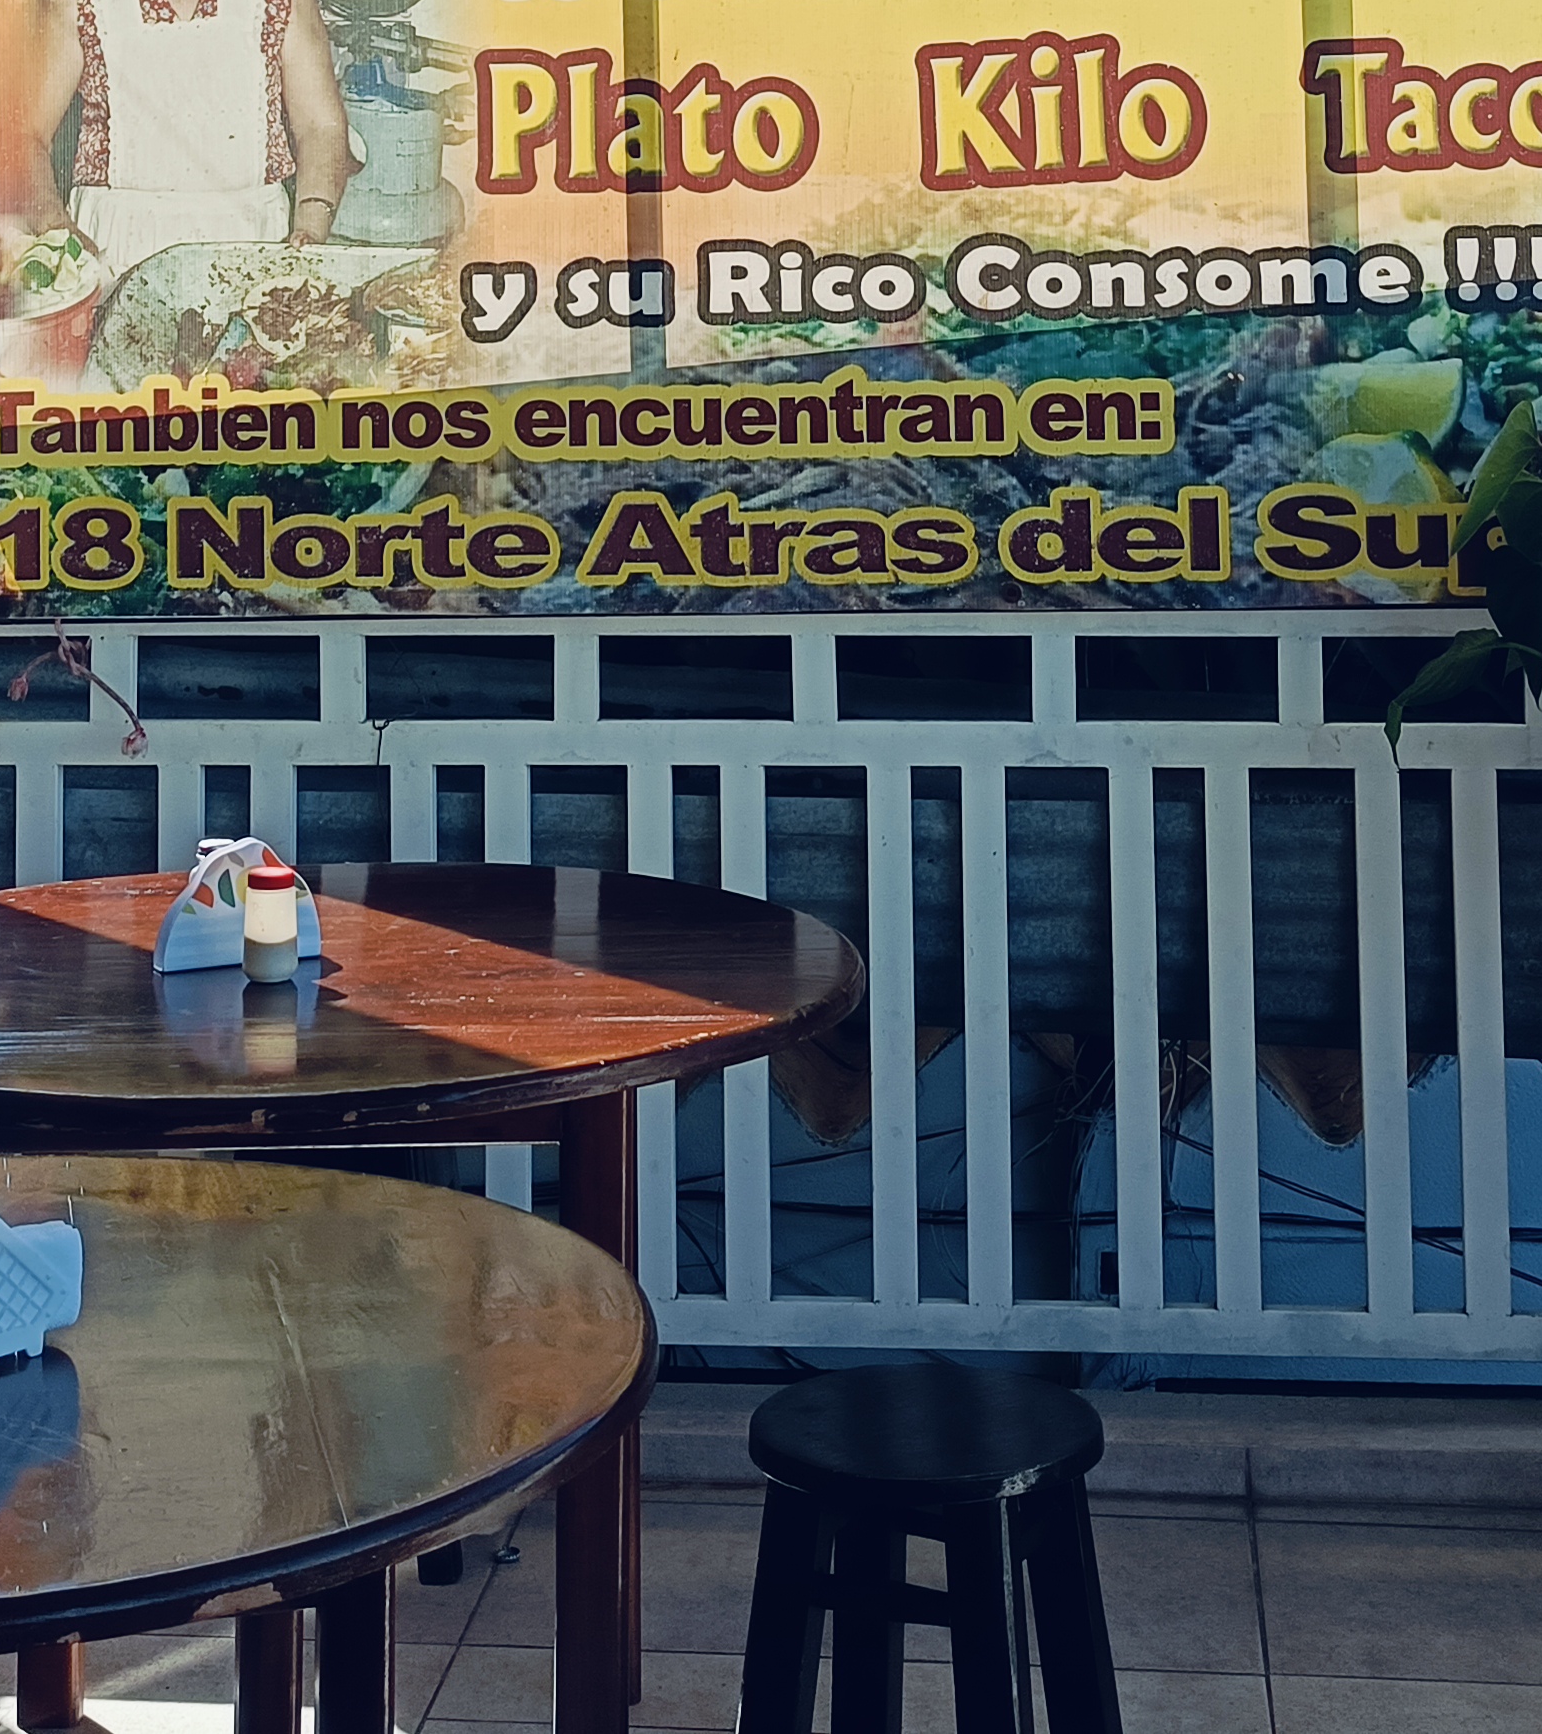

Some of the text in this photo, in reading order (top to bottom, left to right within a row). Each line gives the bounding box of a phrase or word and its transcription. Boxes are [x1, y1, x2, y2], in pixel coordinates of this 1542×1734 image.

[488, 60, 806, 180] Plato
[926, 45, 1194, 177] Kilo
[467, 270, 529, 333] y
[562, 266, 665, 319] su
[708, 250, 915, 316] Rico
[955, 244, 1412, 313] Consome
[342, 399, 491, 451] nos
[514, 378, 1005, 448] encuentran
[1029, 387, 1161, 441] en:
[175, 503, 551, 581] Norte
[586, 500, 967, 579] Atras
[1009, 497, 1221, 575] del
